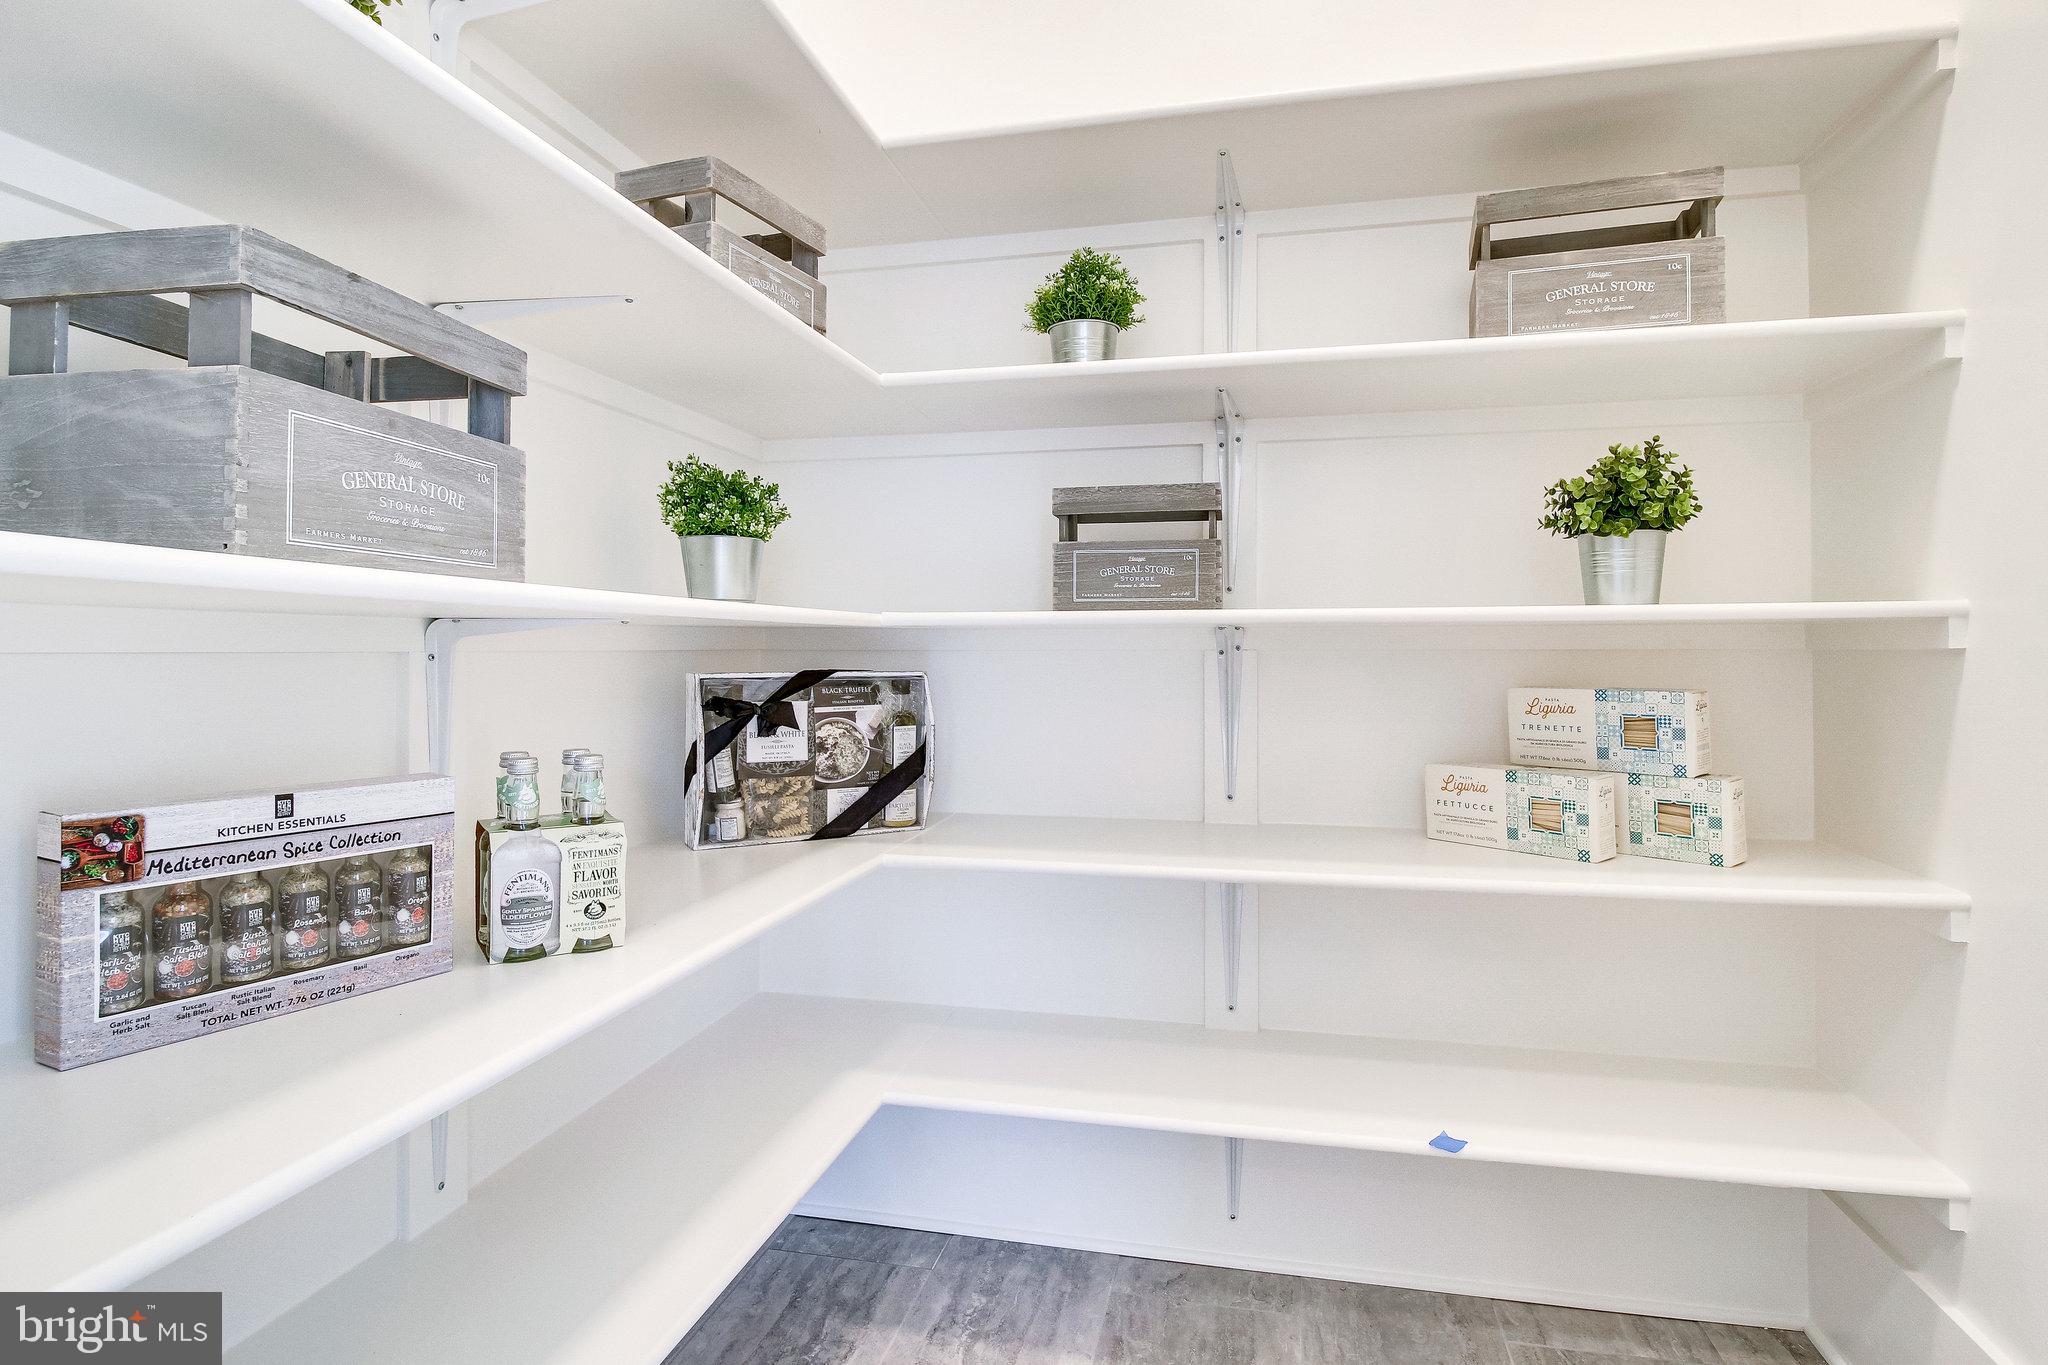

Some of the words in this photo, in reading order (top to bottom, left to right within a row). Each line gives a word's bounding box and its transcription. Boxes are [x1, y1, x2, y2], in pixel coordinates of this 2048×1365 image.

[749, 277, 778, 294] GENERAL
[780, 289, 800, 309] STORE
[1546, 281, 1608, 302] GENERAL
[1610, 280, 1656, 292] STORE
[393, 452, 424, 470] Vintage
[342, 472, 417, 493] GENERAL
[420, 480, 466, 510] STORE
[366, 510, 400, 525] Groceries
[410, 518, 447, 532] Provisions
[1100, 565, 1142, 577] GENERAL
[1144, 565, 1176, 576] STORE
[1525, 698, 1576, 719] Liguria
[1522, 724, 1582, 732] TRENETTE
[1440, 774, 1488, 796] Liguria
[1436, 800, 1494, 812] FETTUCCE
[218, 822, 274, 838] KITCHEN
[278, 814, 347, 831] ESSENTIALS
[146, 848, 276, 876] Mediterranean
[283, 839, 324, 859] Spice
[330, 831, 402, 850] Collection
[572, 847, 618, 860] FENTIMANS
[582, 859, 618, 870] EXQUISITE
[574, 866, 617, 882] FLAVOR
[504, 874, 550, 896] FENTIMANS
[572, 886, 618, 900] SAVORING
[502, 910, 552, 920] ELDERFLOWER
[172, 943, 205, 956] Tuscan
[395, 951, 420, 962] Oregano
[163, 955, 182, 965] Salt
[353, 964, 368, 972] Basil
[294, 974, 326, 986] Rosemary
[232, 992, 253, 1000] Rustic
[254, 986, 276, 995] Italian
[236, 998, 251, 1006] Salt
[252, 992, 272, 1003] Blend
[182, 1002, 206, 1012] Tuscan
[201, 1013, 236, 1028] TOTAL
[240, 1005, 262, 1018] NET
[266, 1000, 284, 1012] WT.
[288, 994, 306, 1007] 7.76
[310, 990, 324, 1000] OZ
[327, 982, 356, 998] (221g)
[176, 1012, 190, 1021] Salt
[192, 1006, 214, 1018] Blend
[110, 1020, 134, 1029] Garlic
[136, 1014, 151, 1023] and
[112, 1026, 133, 1036] Herb
[135, 1022, 150, 1032] Salt
